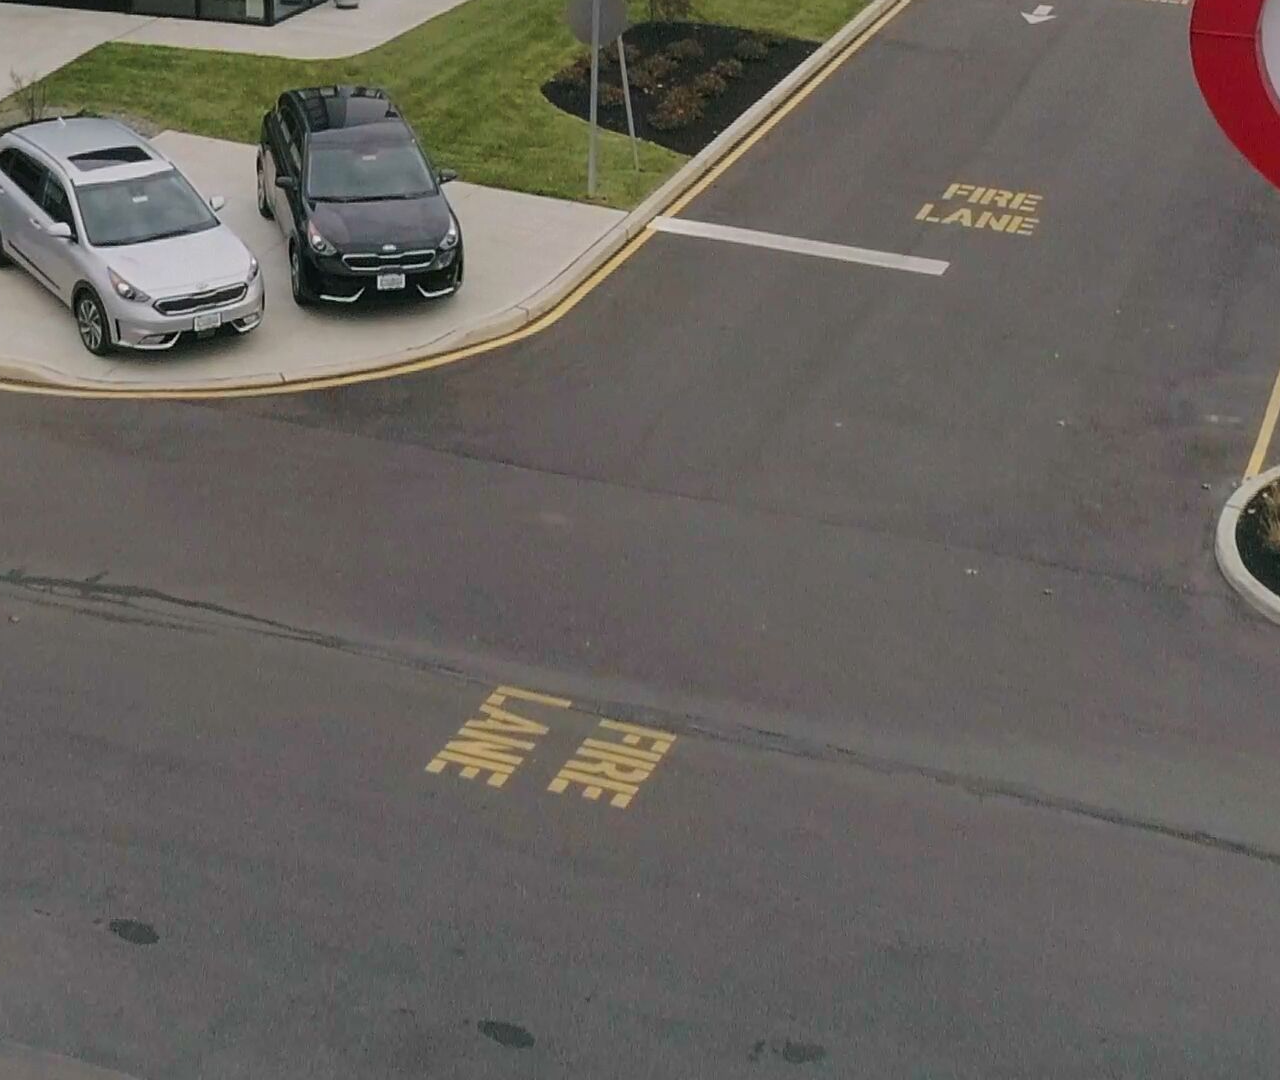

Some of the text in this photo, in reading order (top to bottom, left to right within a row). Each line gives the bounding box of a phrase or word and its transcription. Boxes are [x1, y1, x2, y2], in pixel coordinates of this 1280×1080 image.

[915, 203, 1040, 236] LANE
[941, 182, 1043, 211] FIRE
[423, 684, 573, 789] LANE
[546, 718, 678, 809] FIRE
